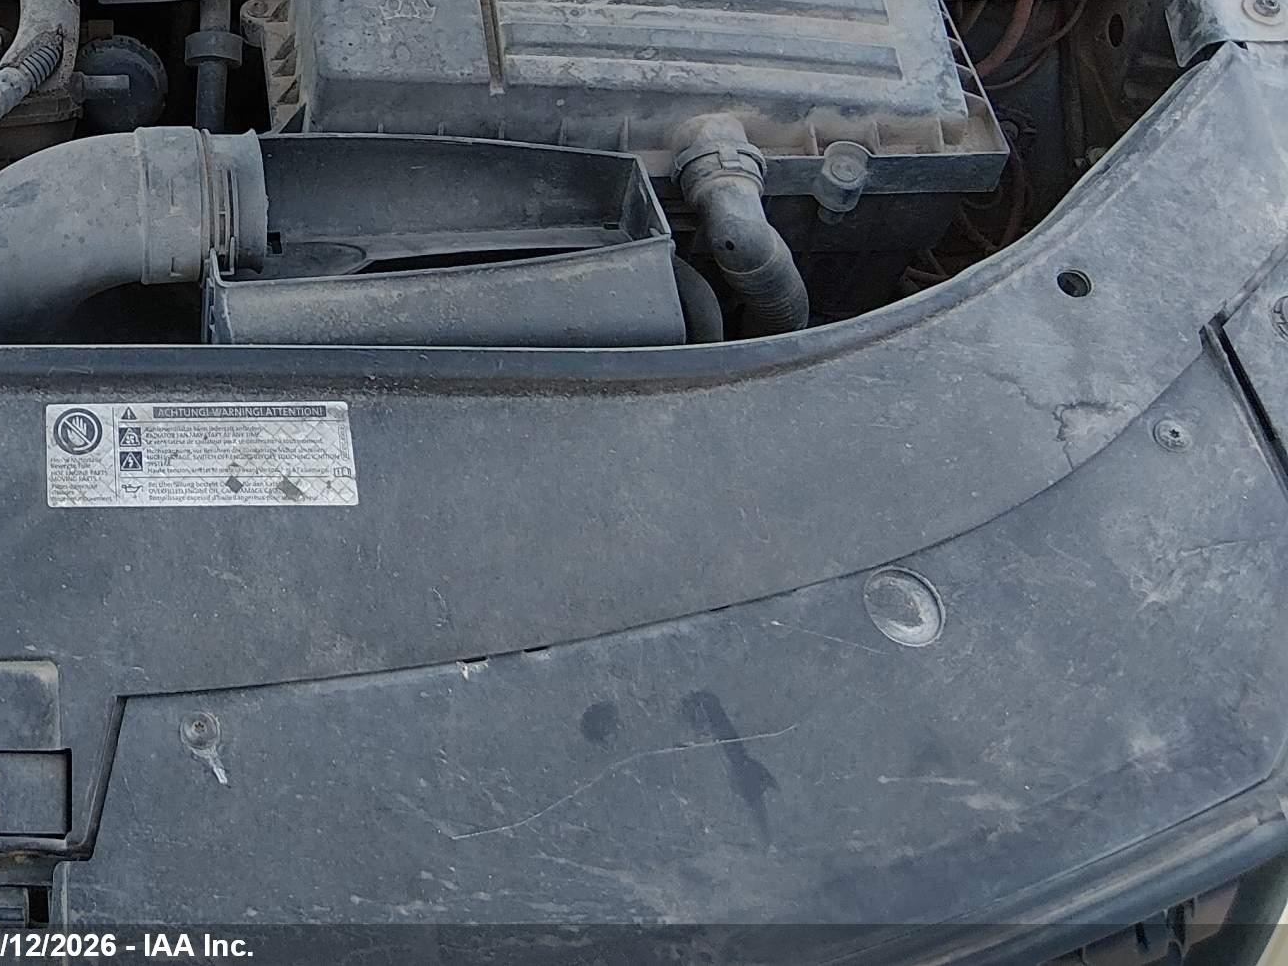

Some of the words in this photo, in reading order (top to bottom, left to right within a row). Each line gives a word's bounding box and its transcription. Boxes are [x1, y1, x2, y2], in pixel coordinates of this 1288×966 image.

[158, 408, 210, 417] ACHTUNG!
[212, 407, 263, 417] WARNING!
[265, 407, 323, 416] ATTENTION!
